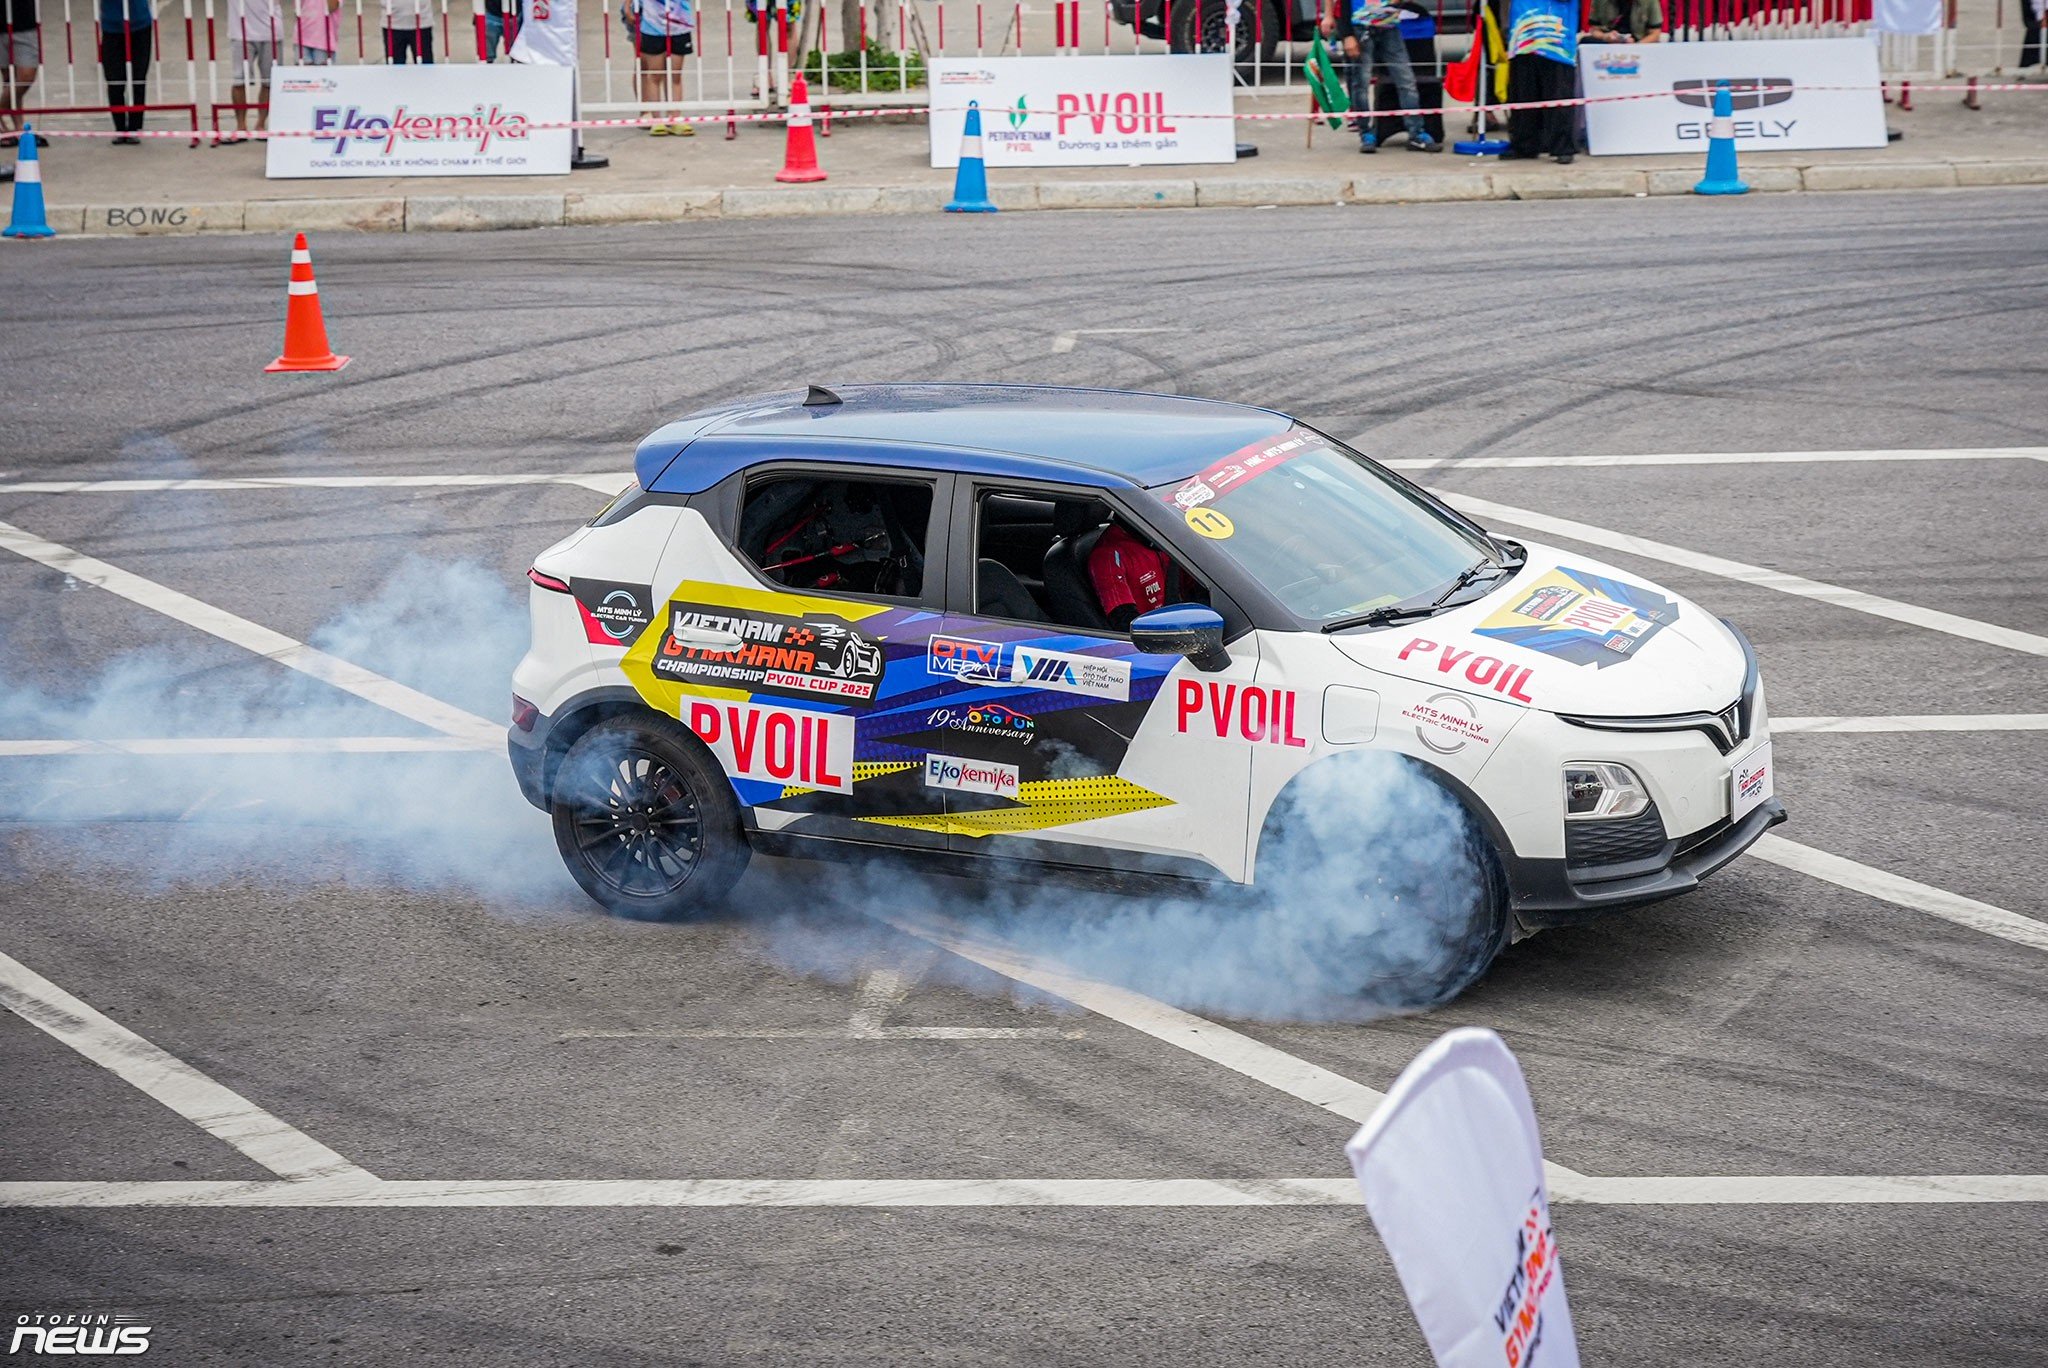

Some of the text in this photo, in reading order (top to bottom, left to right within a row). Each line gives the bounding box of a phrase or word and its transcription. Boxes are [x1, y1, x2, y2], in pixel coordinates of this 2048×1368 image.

[1056, 92, 1177, 135] PVOIL
[314, 104, 527, 155] Ekokemika
[988, 131, 1051, 141] PETROVIETNAM
[1006, 142, 1034, 152] PVOIL
[1106, 141, 1118, 149] xa
[390, 159, 401, 167] XE
[1190, 512, 1226, 532] 11
[597, 606, 613, 614] MTS
[614, 608, 632, 616] MINH
[1563, 600, 1631, 632] PVOIL
[933, 640, 998, 662] OTV
[657, 659, 871, 696] CHAMPIONSHIP PVOIL CUP 2025
[1108, 676, 1124, 684] THAO
[1398, 637, 1535, 704] PVOIL
[1095, 681, 1109, 689] NAM
[968, 711, 1035, 729] OTOFUN
[1177, 678, 1306, 748] PVOIL
[1401, 710, 1490, 744] ELECTRIC CAR TUNING
[1413, 704, 1484, 733] MTS MINH LÝ
[691, 702, 841, 787] PVOIL
[949, 717, 1034, 745] Anniversary
[929, 760, 1015, 791] Ekokemika
